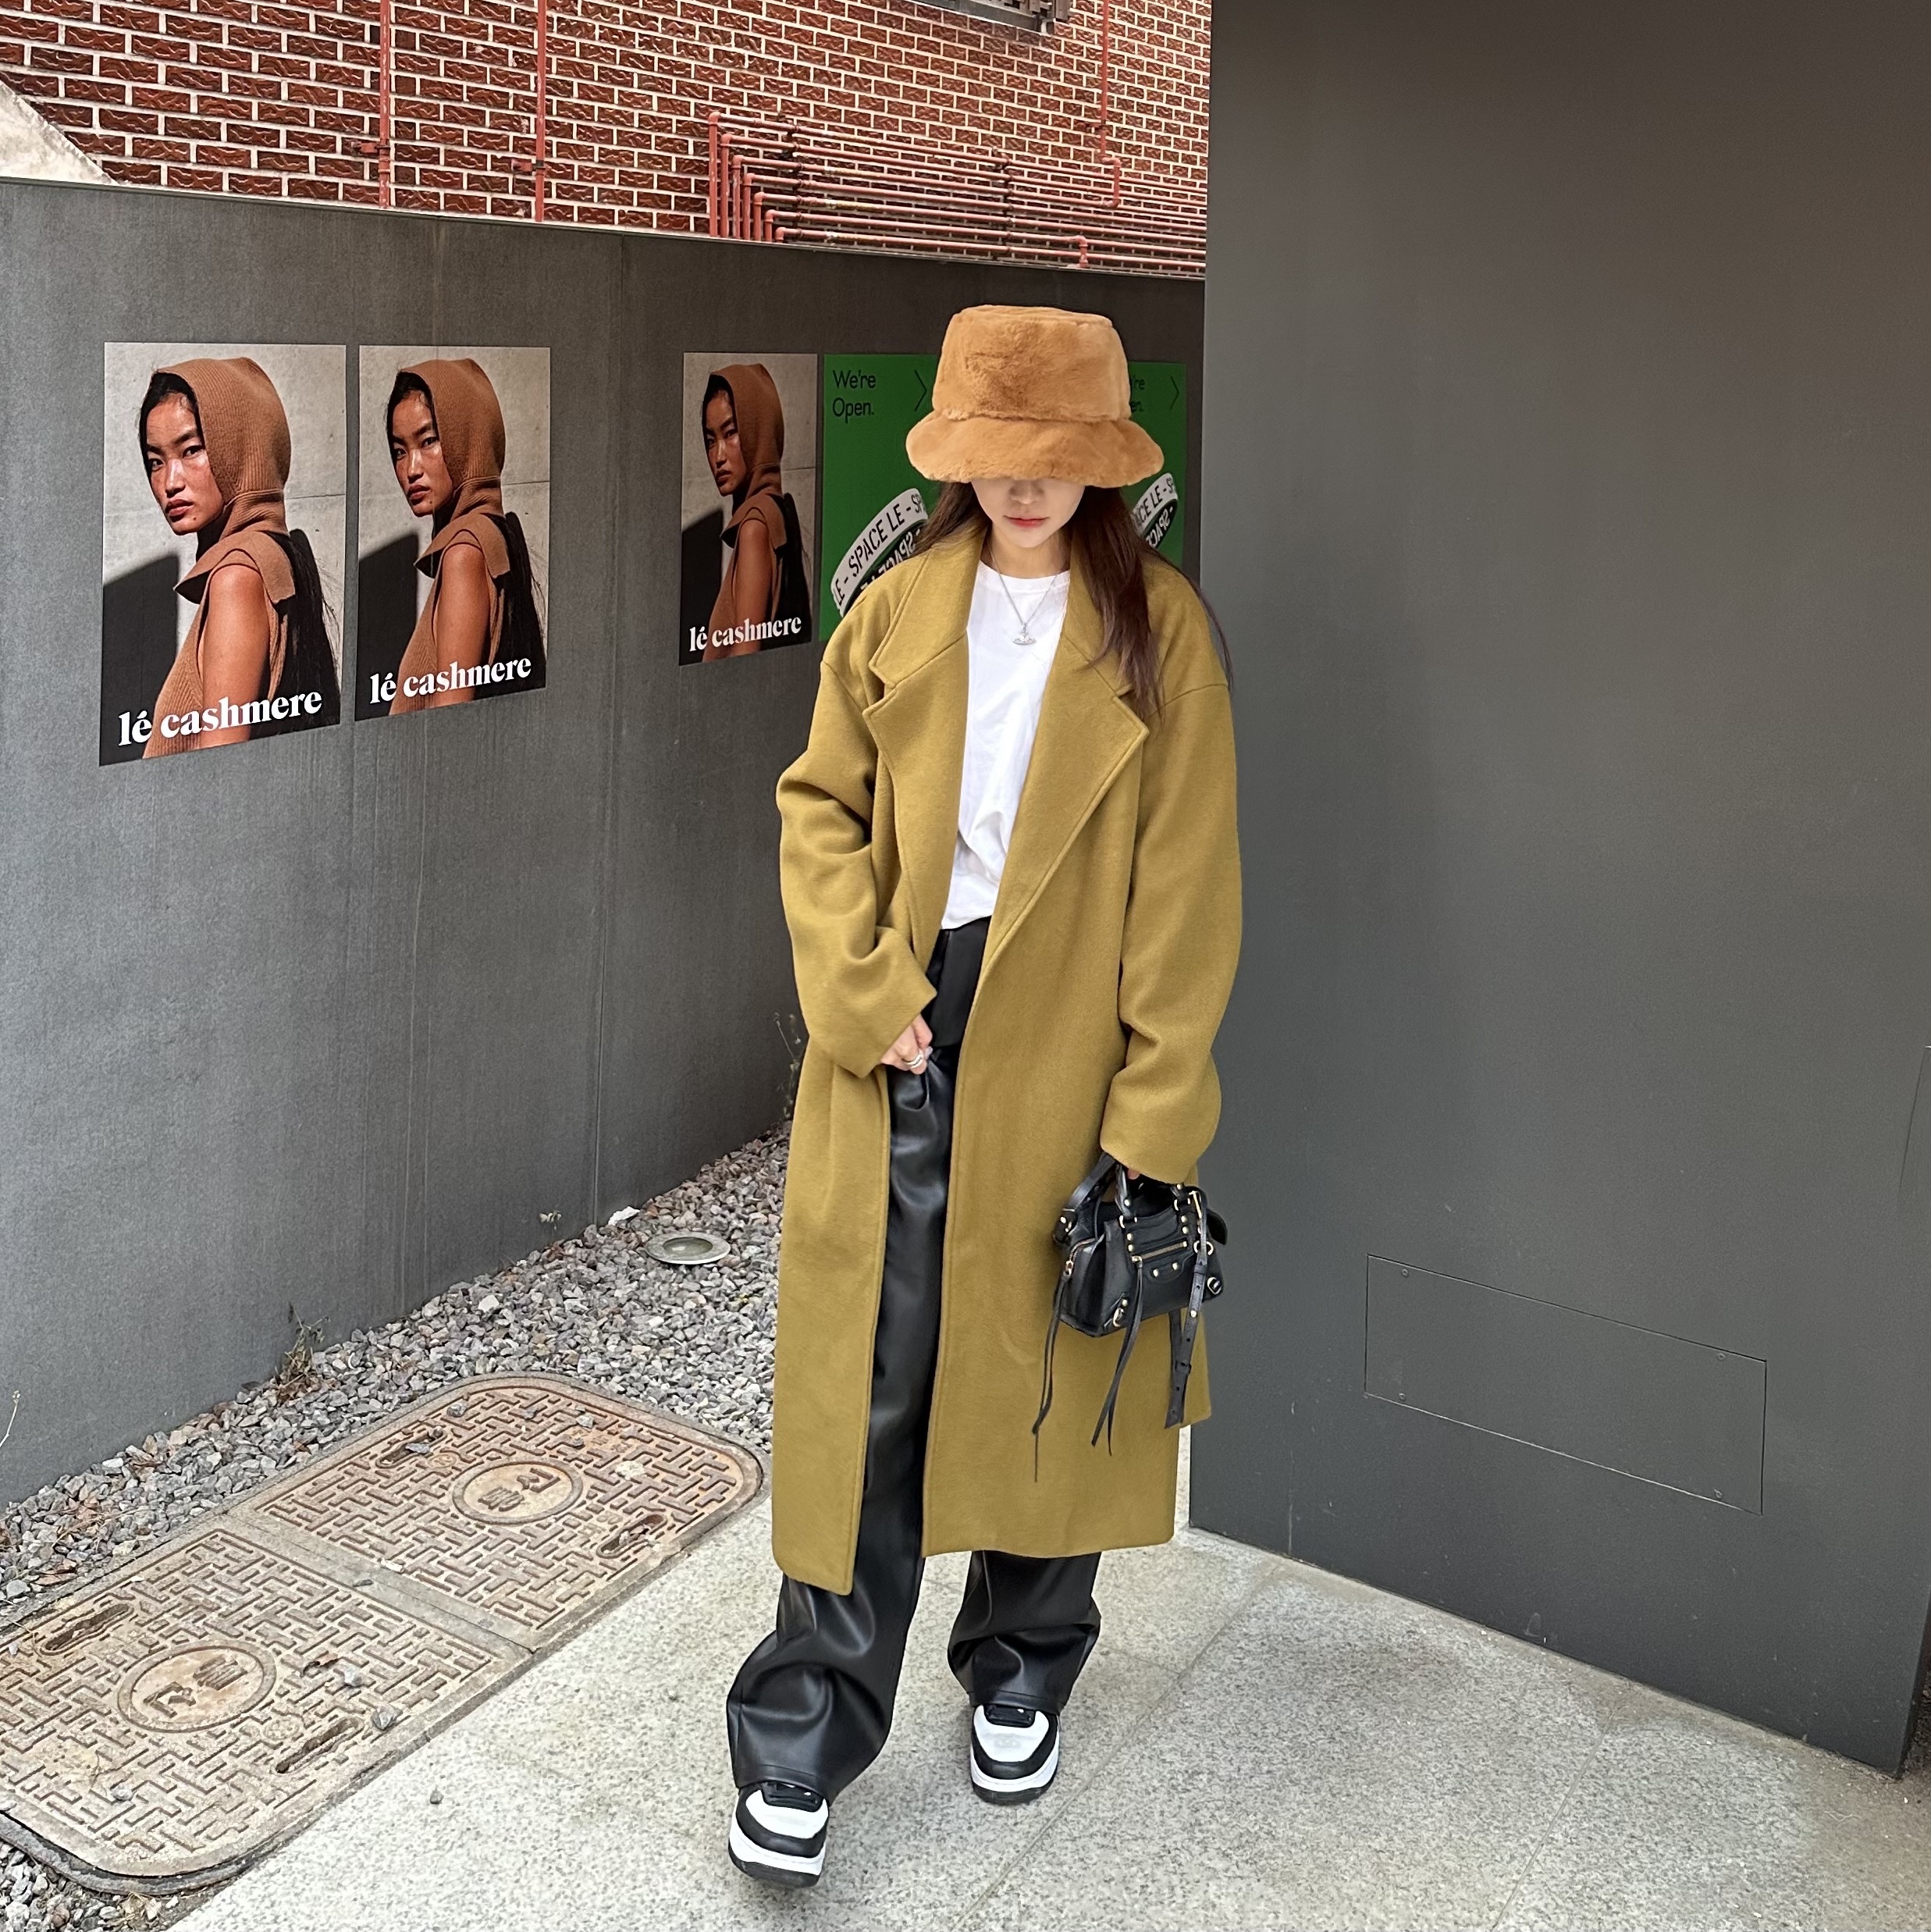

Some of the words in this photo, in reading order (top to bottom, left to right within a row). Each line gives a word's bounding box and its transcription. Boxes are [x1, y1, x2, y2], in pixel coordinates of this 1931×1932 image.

[832, 369, 877, 389] We're
[832, 397, 875, 424] Open.
[1150, 485, 1162, 508] LE
[848, 518, 888, 578] SPACE
[886, 503, 905, 532] LE
[689, 626, 708, 652] lé
[711, 617, 802, 647] cashmere
[370, 672, 397, 704] lé
[403, 657, 532, 698] cashmere
[118, 710, 152, 746] lé
[160, 691, 322, 738] cashmere
[478, 1468, 561, 1512] 통신
